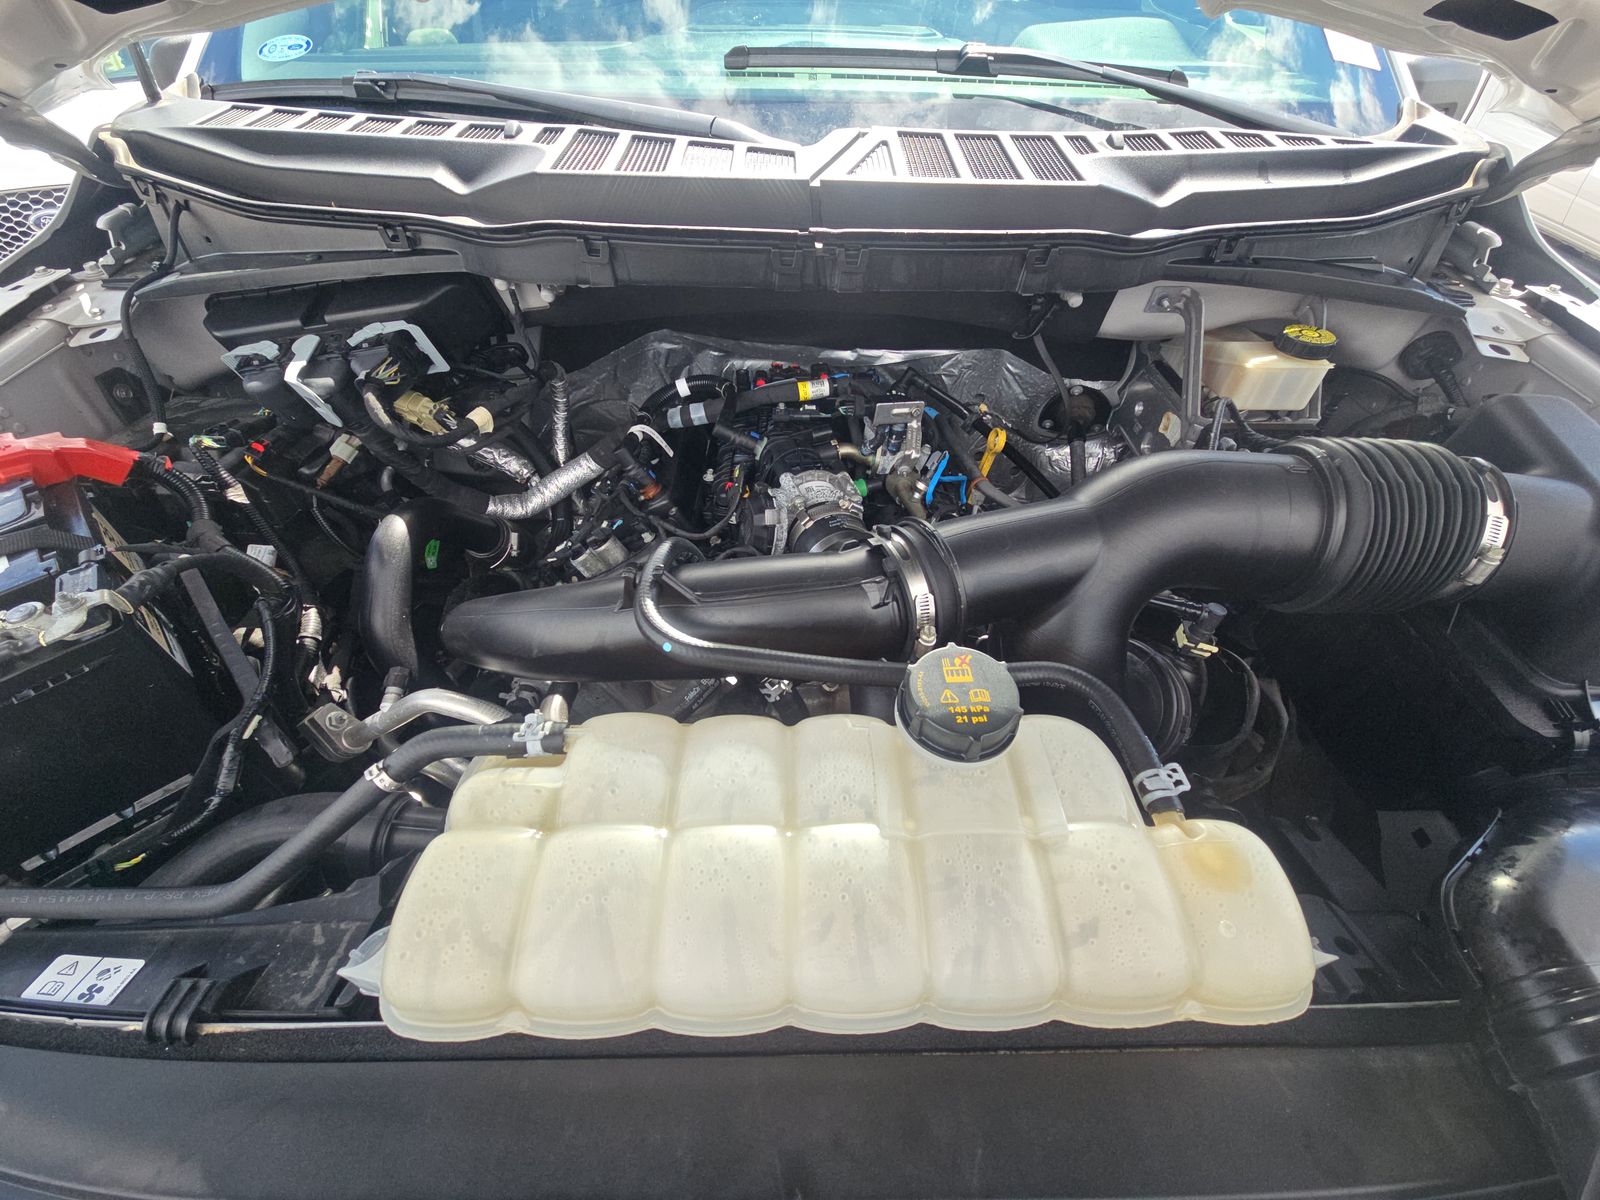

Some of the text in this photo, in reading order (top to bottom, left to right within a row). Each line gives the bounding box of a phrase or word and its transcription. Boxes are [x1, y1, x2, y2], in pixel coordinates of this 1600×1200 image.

[949, 704, 990, 713] 145 kPa
[956, 714, 987, 724] 21 psi
